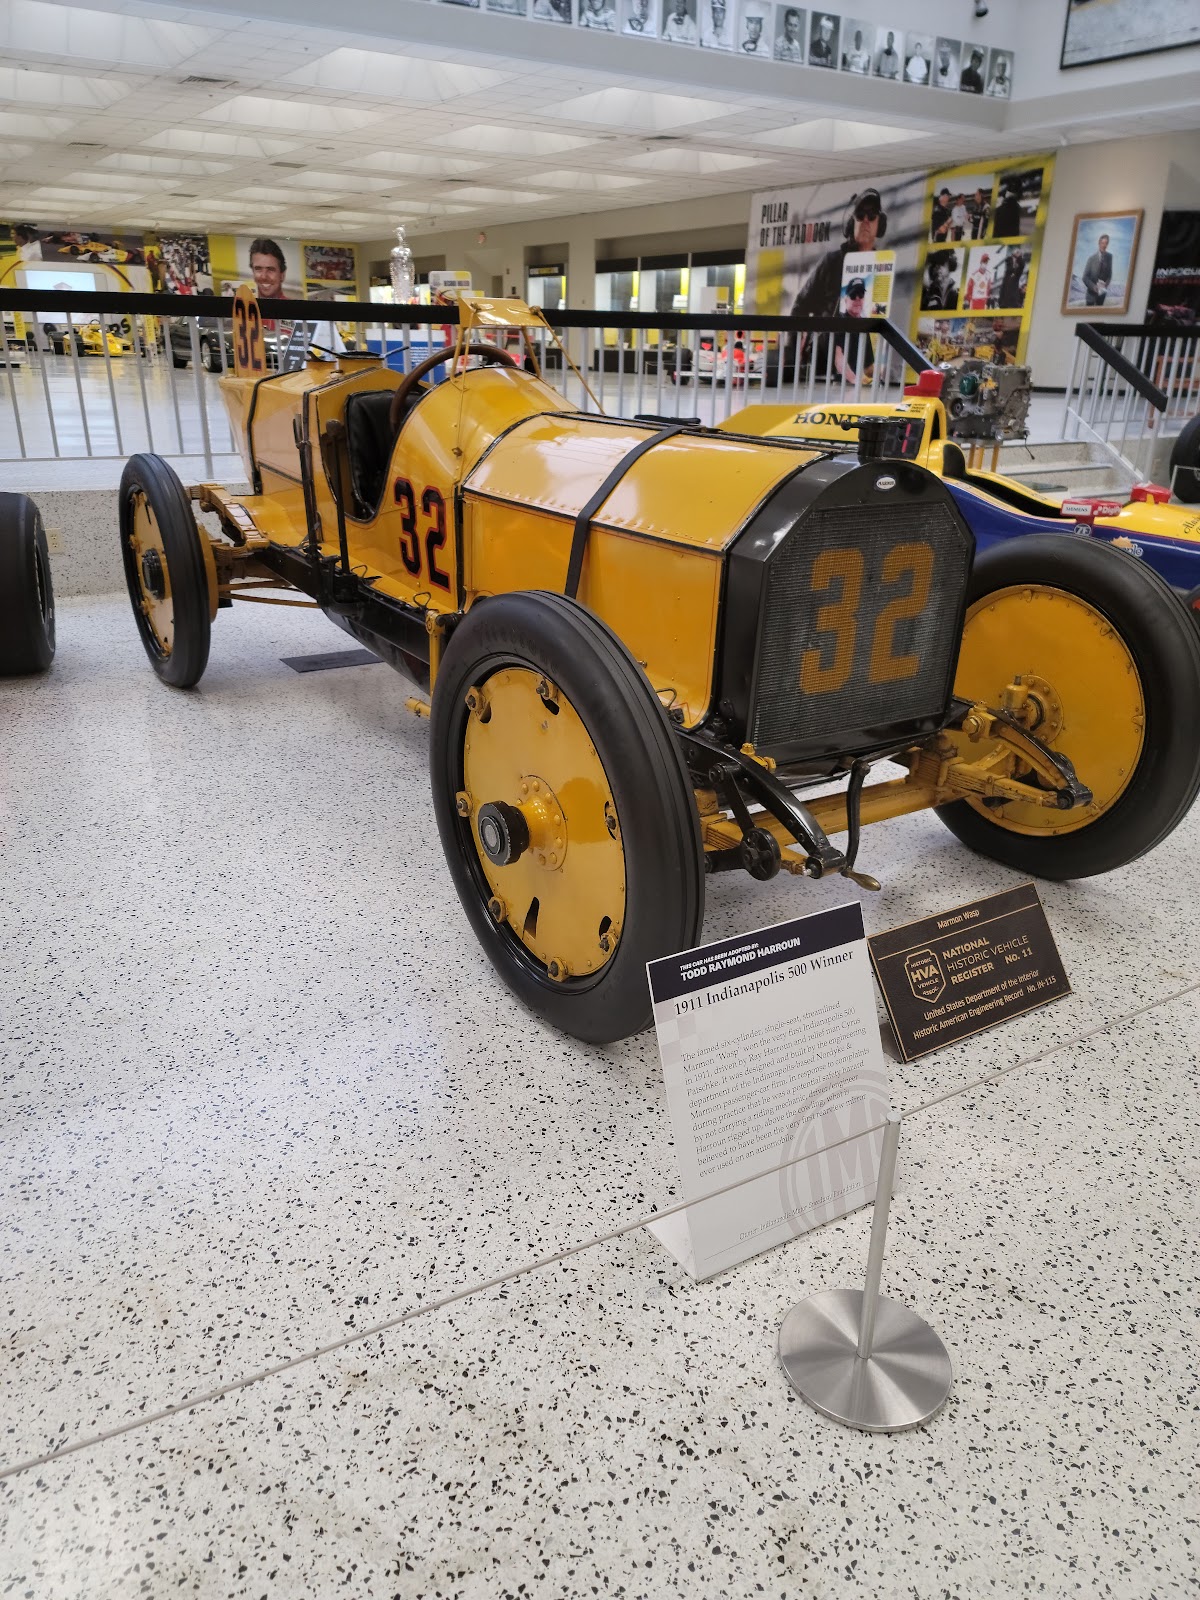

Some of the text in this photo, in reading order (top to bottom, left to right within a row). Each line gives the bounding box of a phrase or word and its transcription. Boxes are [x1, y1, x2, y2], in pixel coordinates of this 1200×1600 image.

[760, 221, 831, 247] OF THE PADDOCK
[761, 202, 788, 224] PILLAR
[234, 297, 262, 371] 32
[394, 477, 451, 593] 32
[800, 542, 935, 694] 32
[937, 910, 980, 929] Marmon Wasp
[943, 937, 989, 959] NATIONAL
[680, 937, 800, 981] TODD RAYMOND HARROUN
[728, 946, 750, 956] ADOPTED
[911, 957, 932, 968] HISTORIC
[911, 965, 939, 983] HVA
[947, 935, 1029, 972] HISTORIC VEHICLE
[951, 947, 1032, 985] REGISTER No. 11
[674, 951, 854, 1014] 1911 Indianapolis 500 Winner
[914, 975, 1056, 1040] Historic American Engineering Record No. IN-115
[918, 978, 938, 989] VEHICLE
[924, 970, 1039, 1021] United States Department of the Interior
[682, 1051, 695, 1062] The
[697, 1042, 719, 1055] famed
[764, 1015, 801, 1032] single-seat,
[802, 1001, 840, 1019] streamlined
[682, 1058, 714, 1072] Marmon
[744, 1042, 758, 1052] won
[760, 1037, 770, 1046] the
[773, 1033, 787, 1042] very
[789, 1025, 801, 1036] first
[803, 1012, 843, 1030] Indianapolis
[844, 1006, 855, 1017] 500
[685, 1017, 860, 1085] in 1911, driven by Ray Harroun and relief man Cyrus
[722, 1075, 727, 1084] It
[730, 1072, 743, 1081] was
[744, 1058, 775, 1075] designed
[777, 1053, 789, 1064] and
[791, 1047, 806, 1059] built
[808, 1045, 816, 1054] by
[817, 1040, 827, 1049] the
[828, 1027, 867, 1044] engineering
[688, 1041, 852, 1107] department of the Indianapolis-based Nordyke &
[690, 1103, 721, 1118] Marmon
[722, 1085, 769, 1109] passenger-car
[772, 1080, 787, 1089] firm.
[797, 1064, 826, 1078] response
[835, 1048, 869, 1064] complaints
[692, 1118, 717, 1130] during
[718, 1107, 745, 1123] practice
[748, 1099, 760, 1110] that
[762, 1096, 770, 1105] he
[773, 1092, 785, 1101] was
[792, 1076, 820, 1095] potential
[823, 1070, 840, 1082] safety
[842, 1059, 864, 1073] hazard
[694, 1134, 704, 1143] by
[706, 1127, 717, 1138] not
[717, 1118, 747, 1132] carrying
[754, 1107, 774, 1119] riding
[775, 1094, 807, 1110] mechanic,
[808, 1074, 858, 1097] driver/engineer
[695, 1138, 726, 1153] Harroun
[728, 1127, 750, 1141] rigged
[752, 1124, 763, 1133] up,
[765, 1115, 784, 1127] above
[786, 1110, 796, 1119] the
[797, 1100, 825, 1113] cowling,
[827, 1090, 843, 1102] what
[696, 1094, 866, 1165] believed to have been the very first rearview mirror
[700, 1166, 715, 1177] ever
[717, 1157, 733, 1169] used
[736, 1155, 744, 1163] on
[755, 1134, 795, 1153] automobile.
